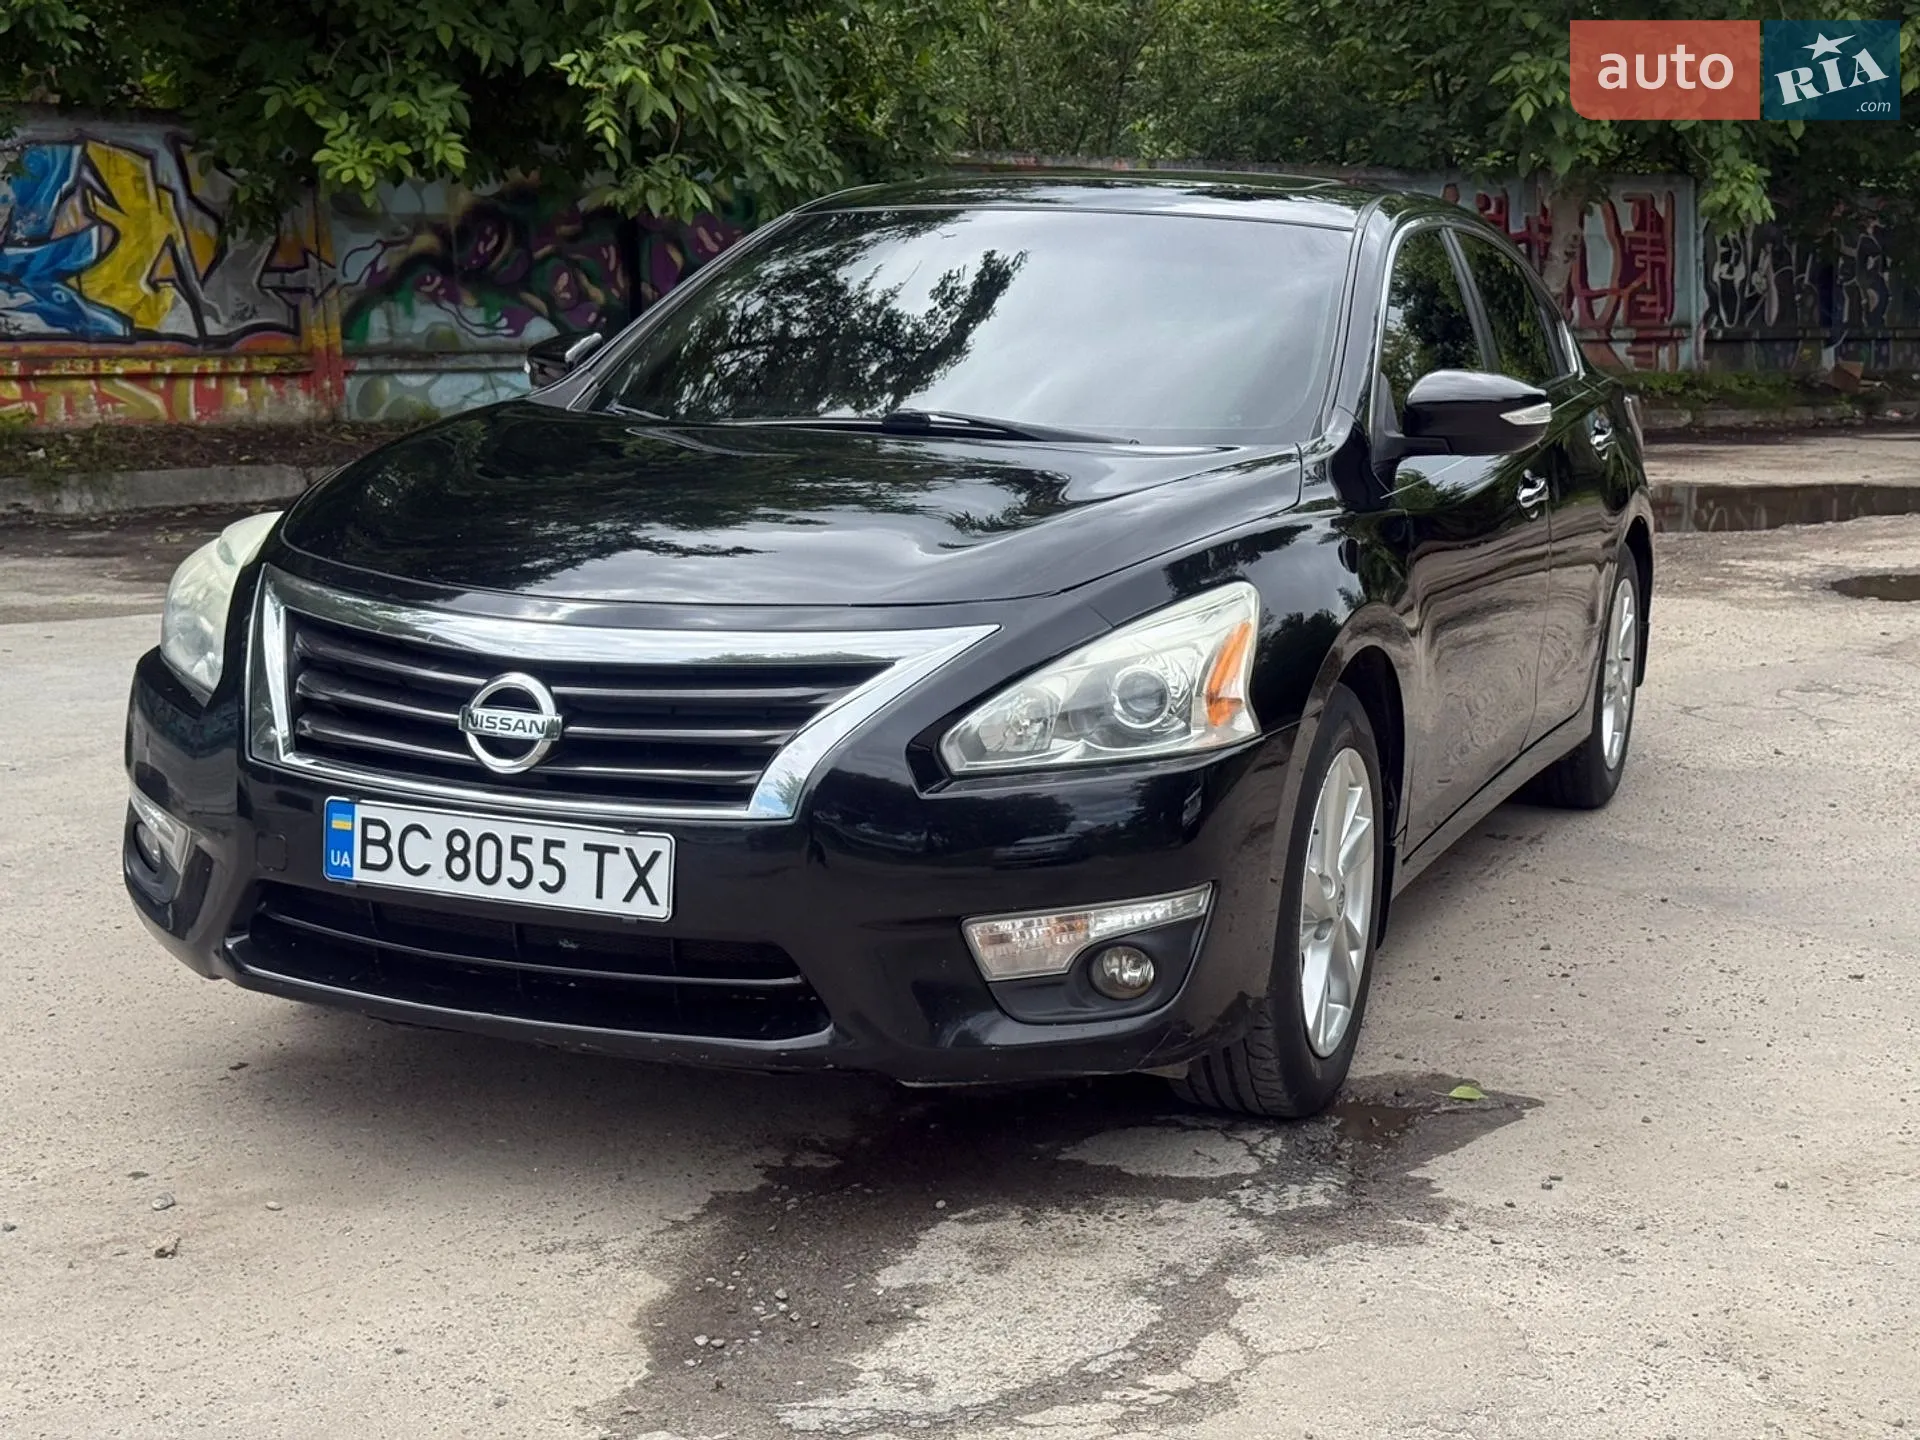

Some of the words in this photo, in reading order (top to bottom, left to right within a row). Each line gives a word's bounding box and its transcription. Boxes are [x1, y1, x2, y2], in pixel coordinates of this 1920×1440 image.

[467, 713, 546, 735] NISSAN
[330, 850, 351, 868] UA
[360, 816, 432, 876] BC
[445, 828, 567, 894] 8055
[583, 842, 662, 906] TX
